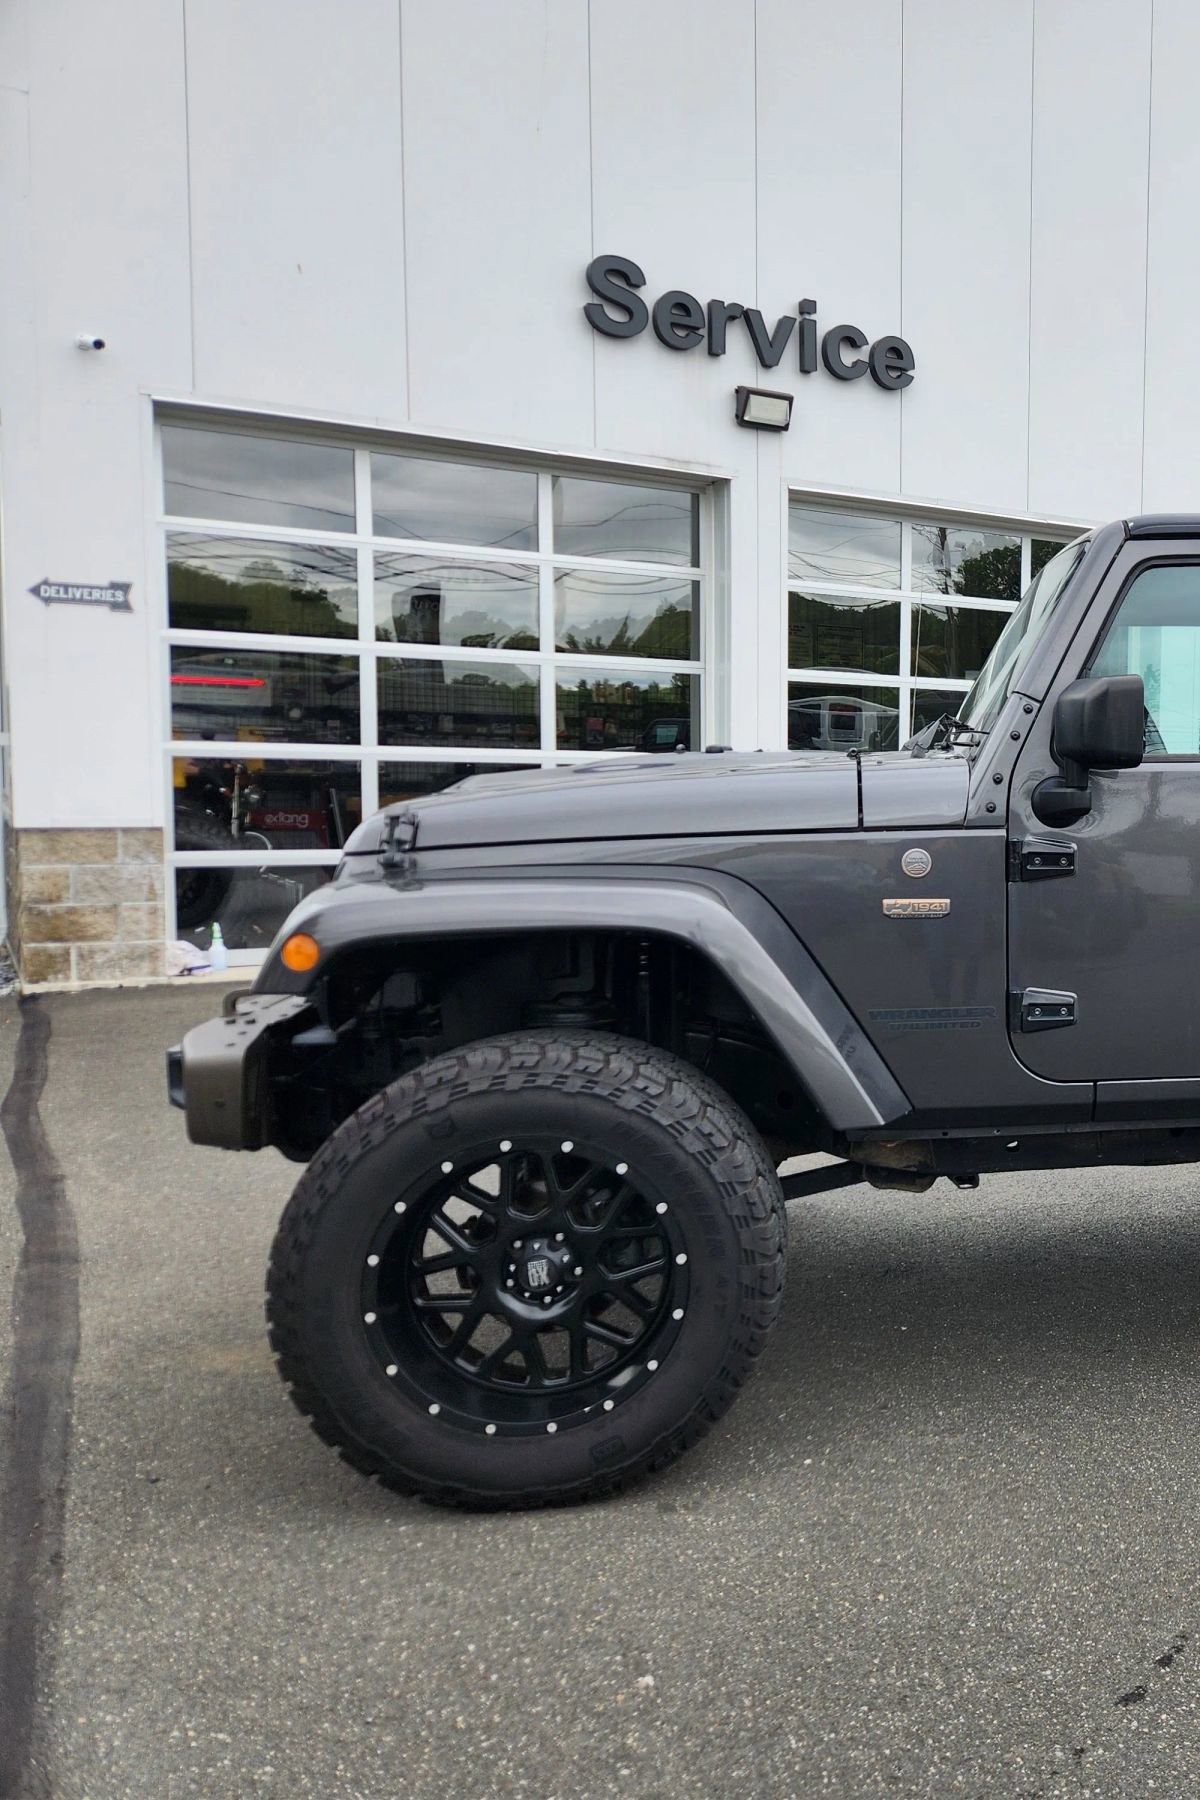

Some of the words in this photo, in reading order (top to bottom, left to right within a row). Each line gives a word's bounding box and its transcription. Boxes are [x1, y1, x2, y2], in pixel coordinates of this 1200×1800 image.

[584, 254, 915, 390] Service
[40, 584, 125, 602] DELIVERIES
[912, 902, 946, 912] 1941
